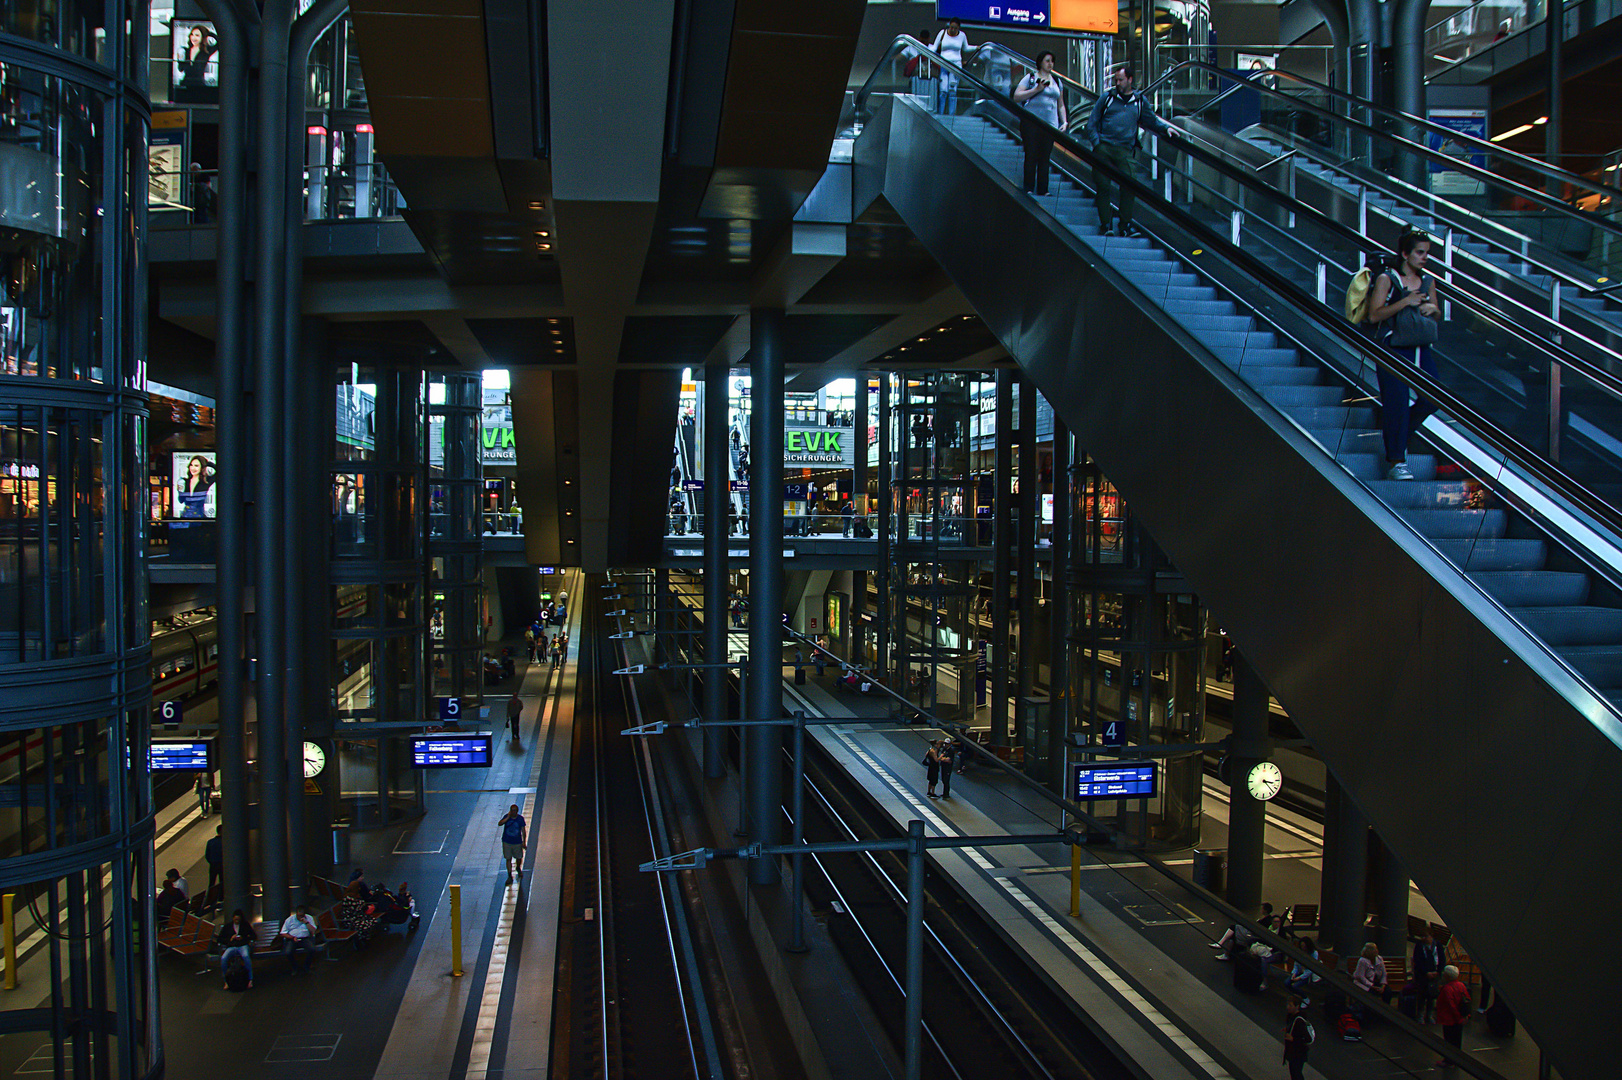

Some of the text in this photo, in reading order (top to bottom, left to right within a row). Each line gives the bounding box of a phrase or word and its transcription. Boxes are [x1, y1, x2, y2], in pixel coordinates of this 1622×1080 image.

[1007, 7, 1029, 17] Ausgang
[784, 431, 841, 452] EVK
[786, 485, 800, 494] 1-2
[541, 610, 548, 619] C
[162, 701, 174, 718] 6
[448, 698, 459, 714] 5
[1106, 722, 1117, 739] 4
